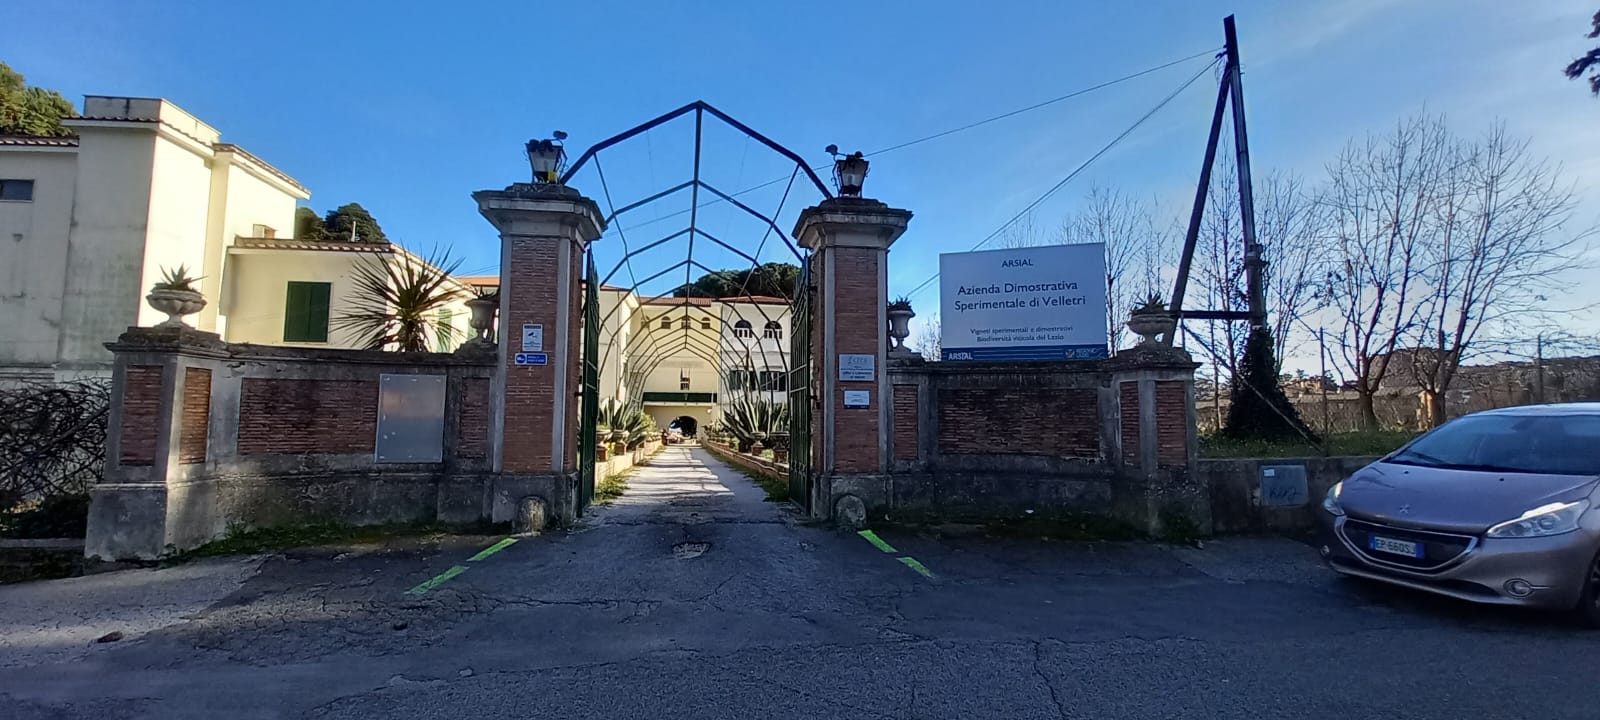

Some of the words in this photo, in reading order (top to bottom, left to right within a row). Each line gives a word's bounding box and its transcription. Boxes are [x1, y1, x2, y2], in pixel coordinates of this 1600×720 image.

[1001, 259, 1033, 268] ARSIAL
[957, 285, 1000, 296] Azienda
[1004, 281, 1078, 293] Dimostrativa
[954, 297, 1026, 312] Sperimentale
[1029, 297, 1040, 307] di
[1041, 295, 1086, 306] Velletri
[992, 327, 1028, 335] sperimentali
[948, 352, 974, 361] ARSIAL
